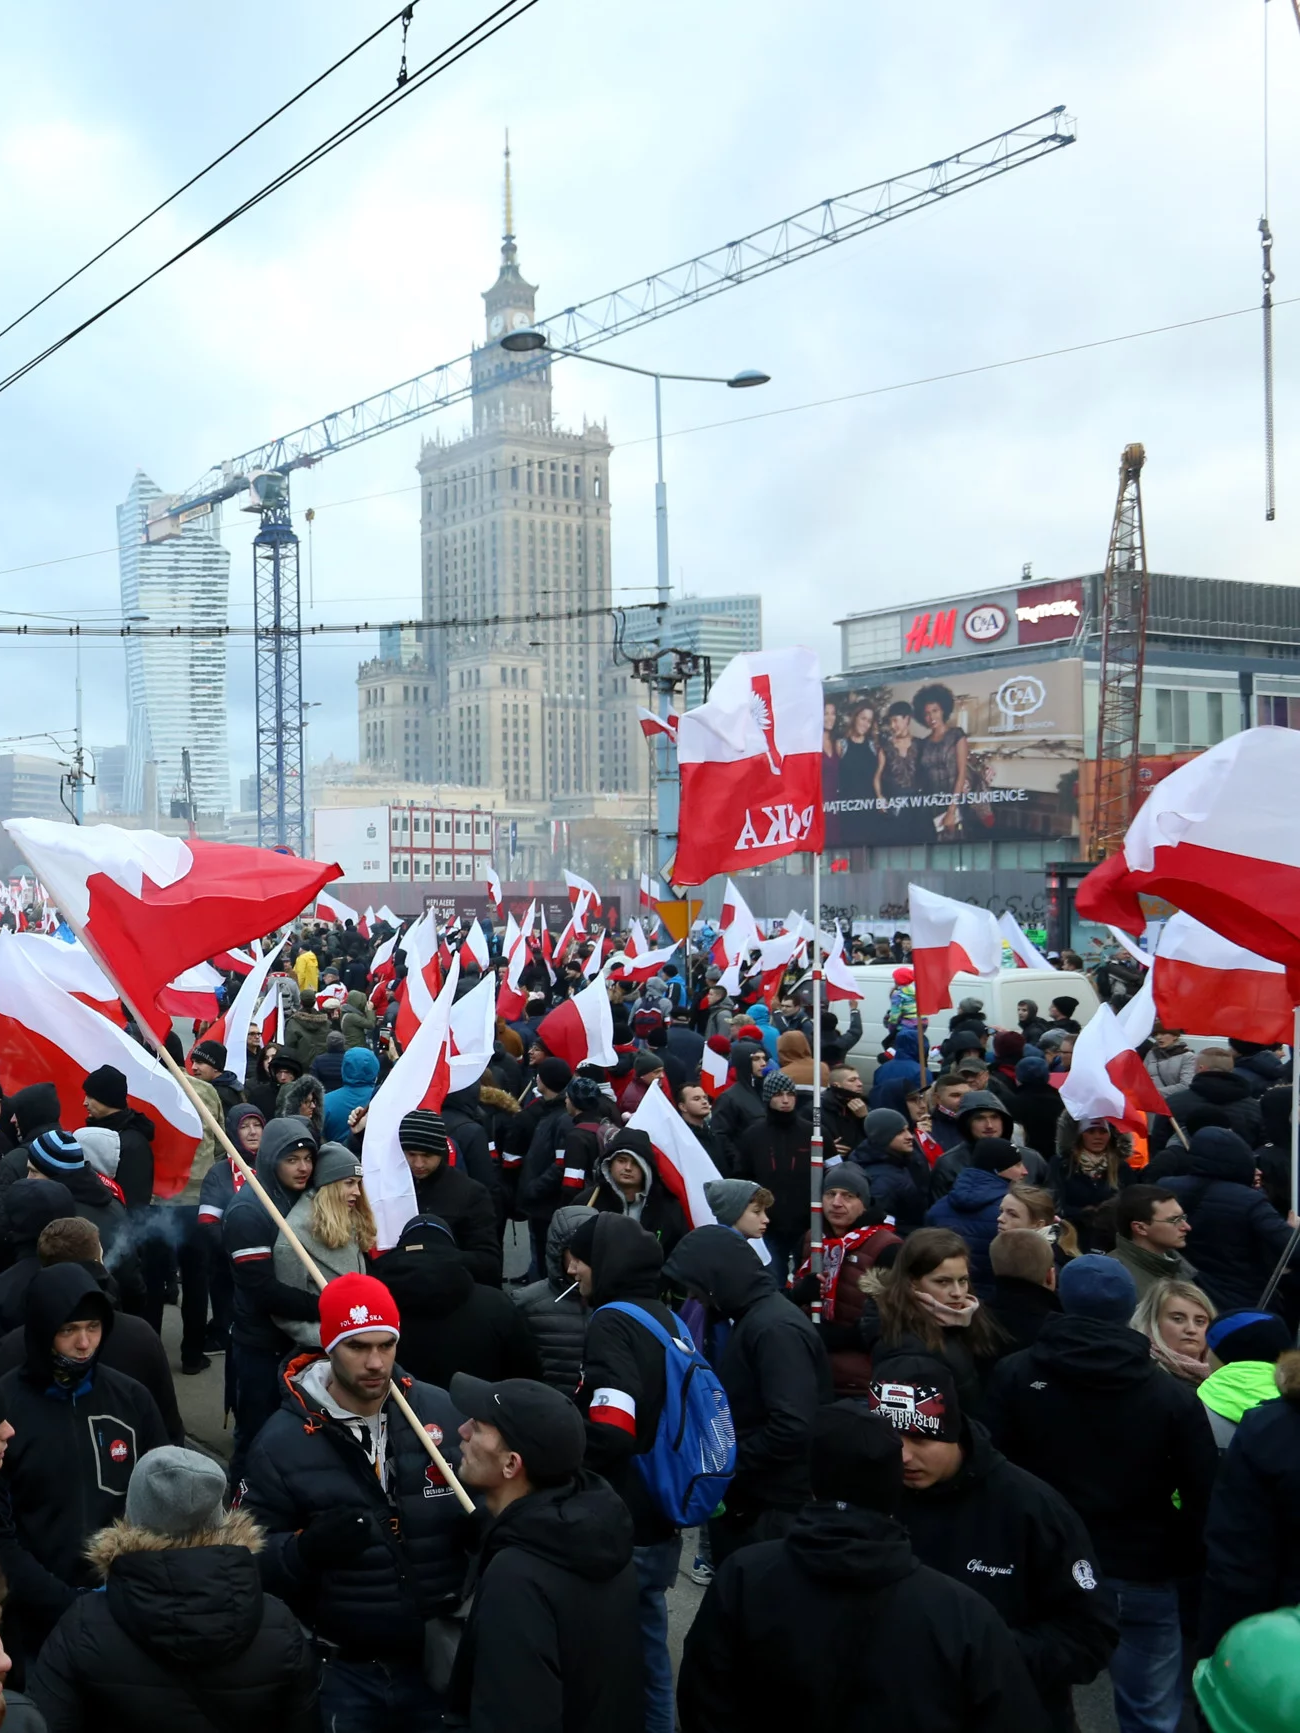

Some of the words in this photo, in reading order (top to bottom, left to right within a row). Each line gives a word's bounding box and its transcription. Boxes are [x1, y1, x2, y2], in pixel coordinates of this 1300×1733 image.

[905, 608, 958, 654] H&M
[969, 613, 1000, 634] C&A
[822, 799, 875, 815] WIĄTECZNY
[875, 796, 909, 811] BLASK
[910, 796, 922, 808] W
[923, 791, 966, 808] KAŻDEJ
[966, 789, 1029, 805] SUKIENCE.
[340, 1319, 351, 1328] POL
